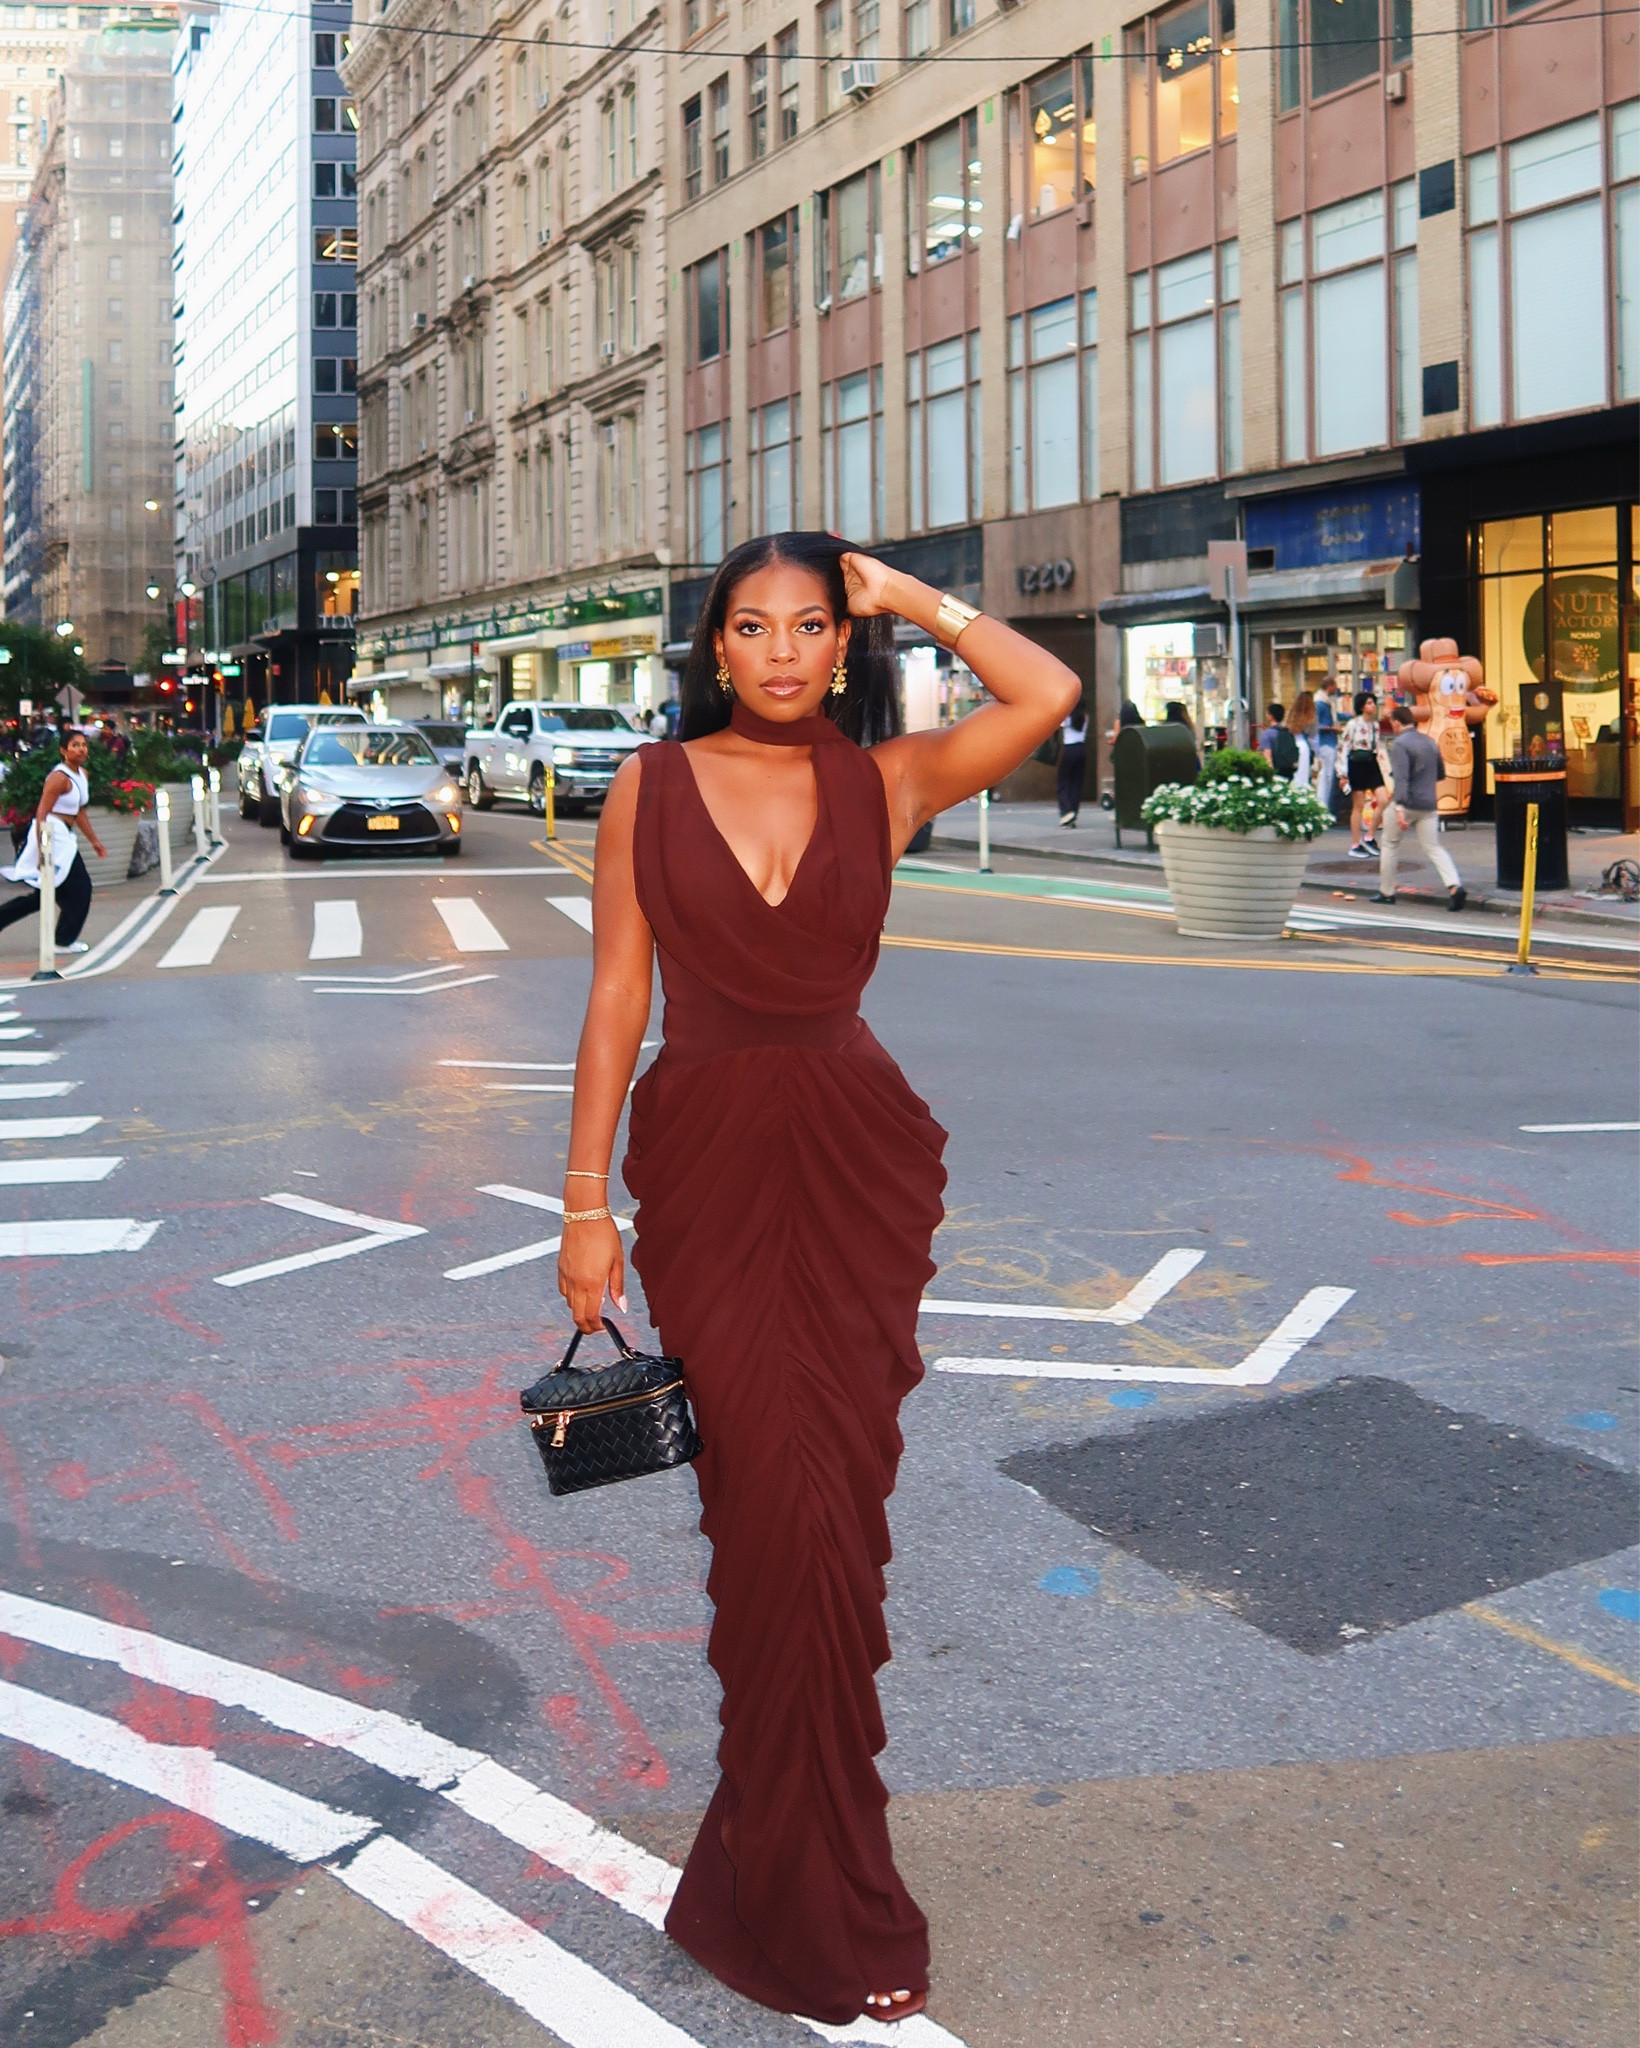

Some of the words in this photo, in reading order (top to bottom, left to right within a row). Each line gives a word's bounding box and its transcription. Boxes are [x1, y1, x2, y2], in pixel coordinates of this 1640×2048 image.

[1016, 557, 1076, 596] 1220
[1553, 592, 1618, 613] NUTS
[1570, 631, 1601, 640] NOMAD
